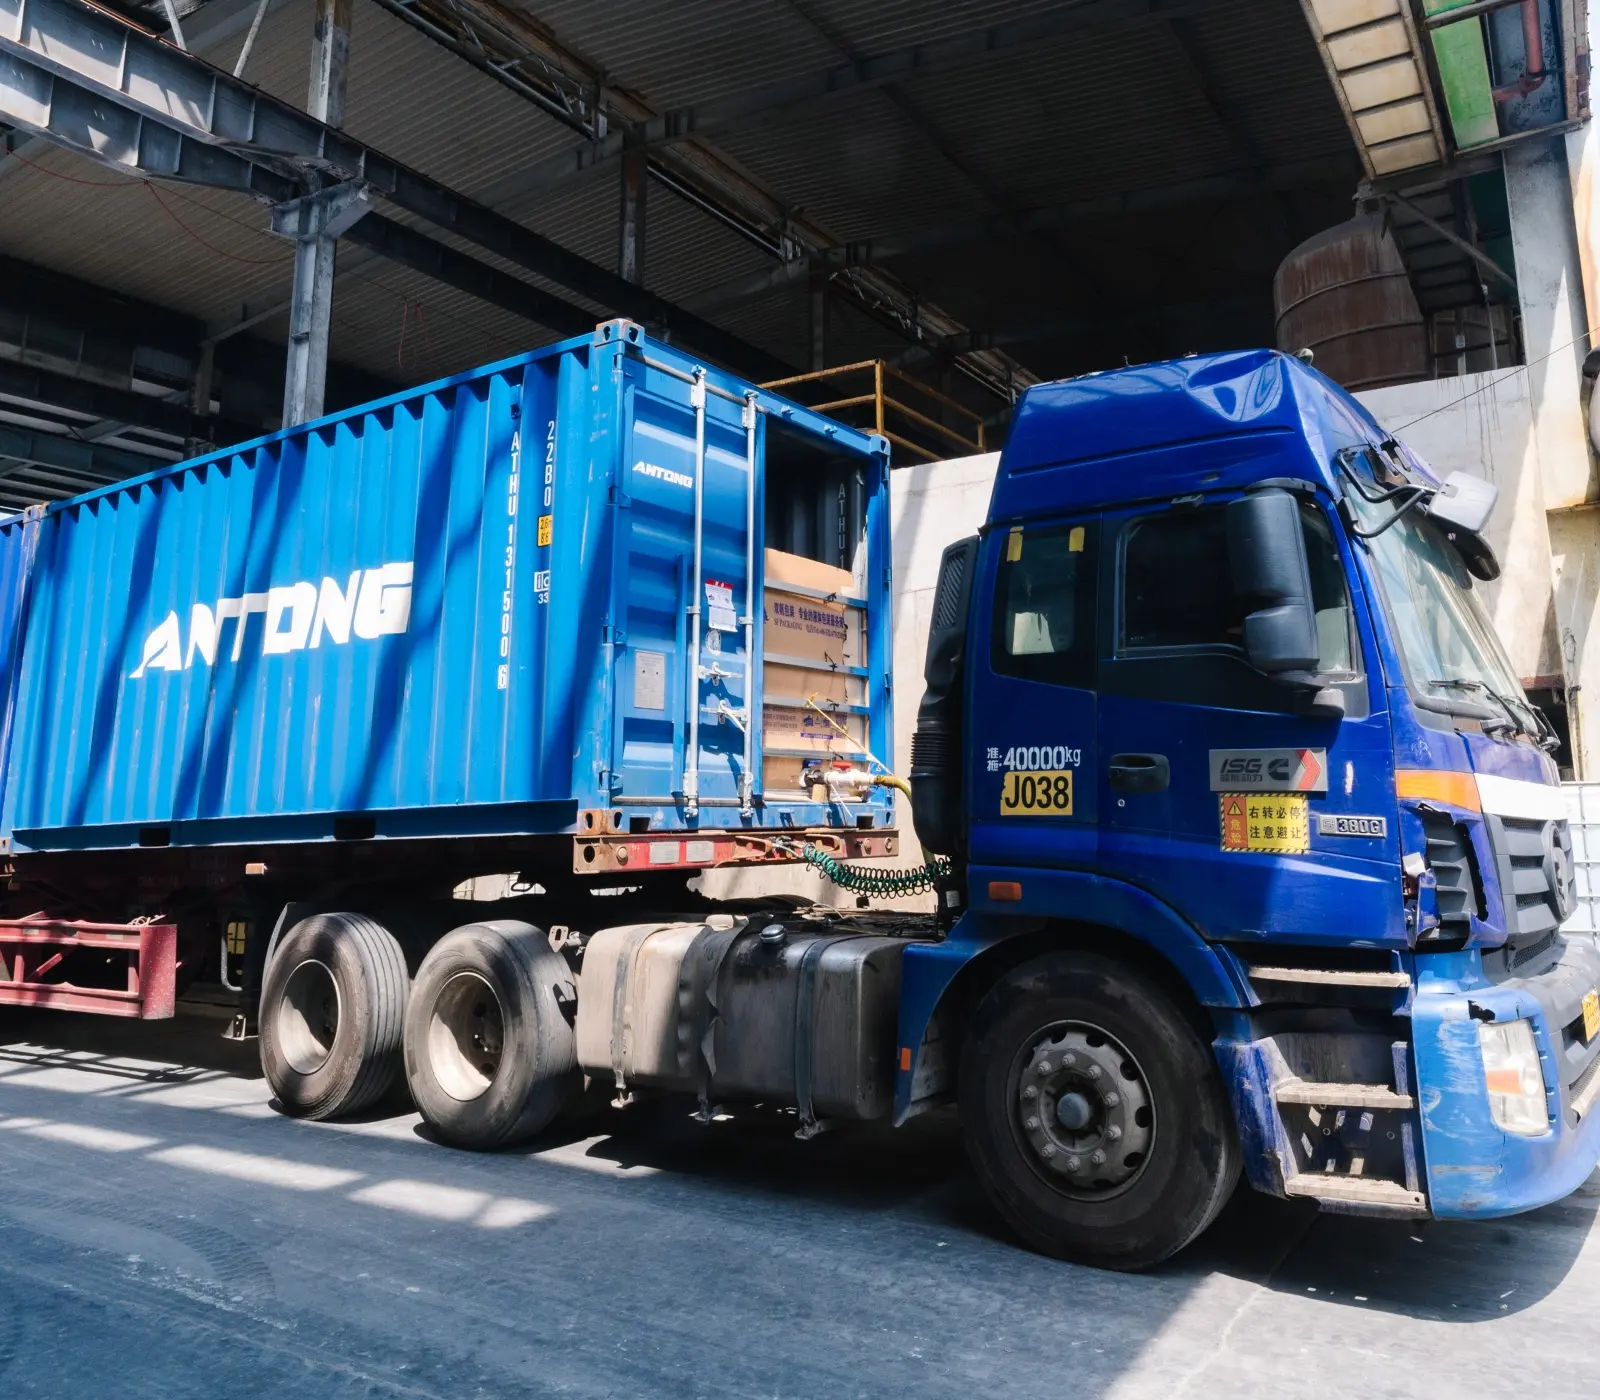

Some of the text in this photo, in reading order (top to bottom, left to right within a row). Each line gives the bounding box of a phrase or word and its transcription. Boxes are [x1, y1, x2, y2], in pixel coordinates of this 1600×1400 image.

[543, 420, 555, 507] 22B0
[632, 460, 694, 489] ANTONG
[838, 483, 846, 550] ATHU
[498, 431, 520, 690] ATHU 131500 6
[538, 592, 549, 605] 33
[128, 561, 414, 679] ANTONG
[1220, 758, 1263, 774] ISG
[1004, 775, 1070, 809] J038
[1248, 805, 1302, 820] 右转必停
[1338, 817, 1381, 835] 380G
[1249, 825, 1302, 841] 注意避让
